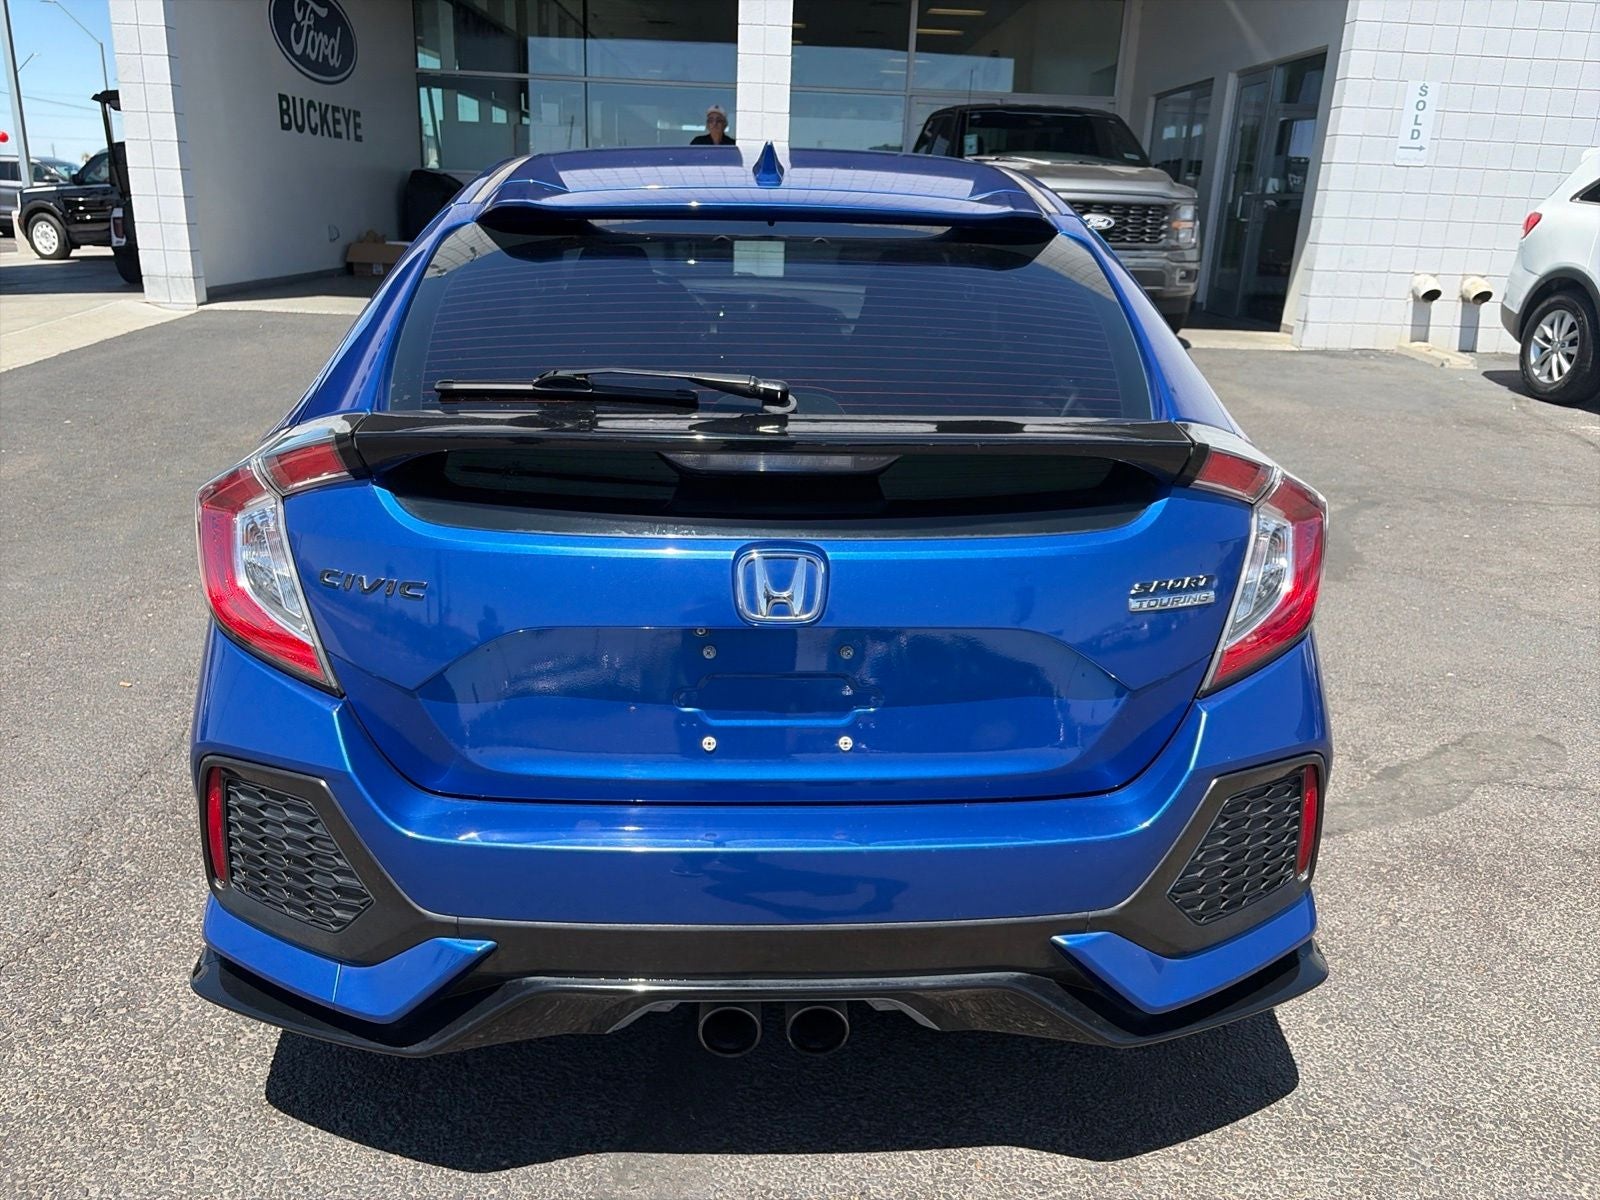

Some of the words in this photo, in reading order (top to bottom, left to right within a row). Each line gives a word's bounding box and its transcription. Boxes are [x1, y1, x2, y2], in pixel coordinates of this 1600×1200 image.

[290, 0, 342, 68] Ford
[277, 92, 364, 143] BUCKEYE
[1410, 83, 1429, 140] SOLD
[320, 568, 428, 601] CIVIC
[1131, 592, 1212, 610] TOURING
